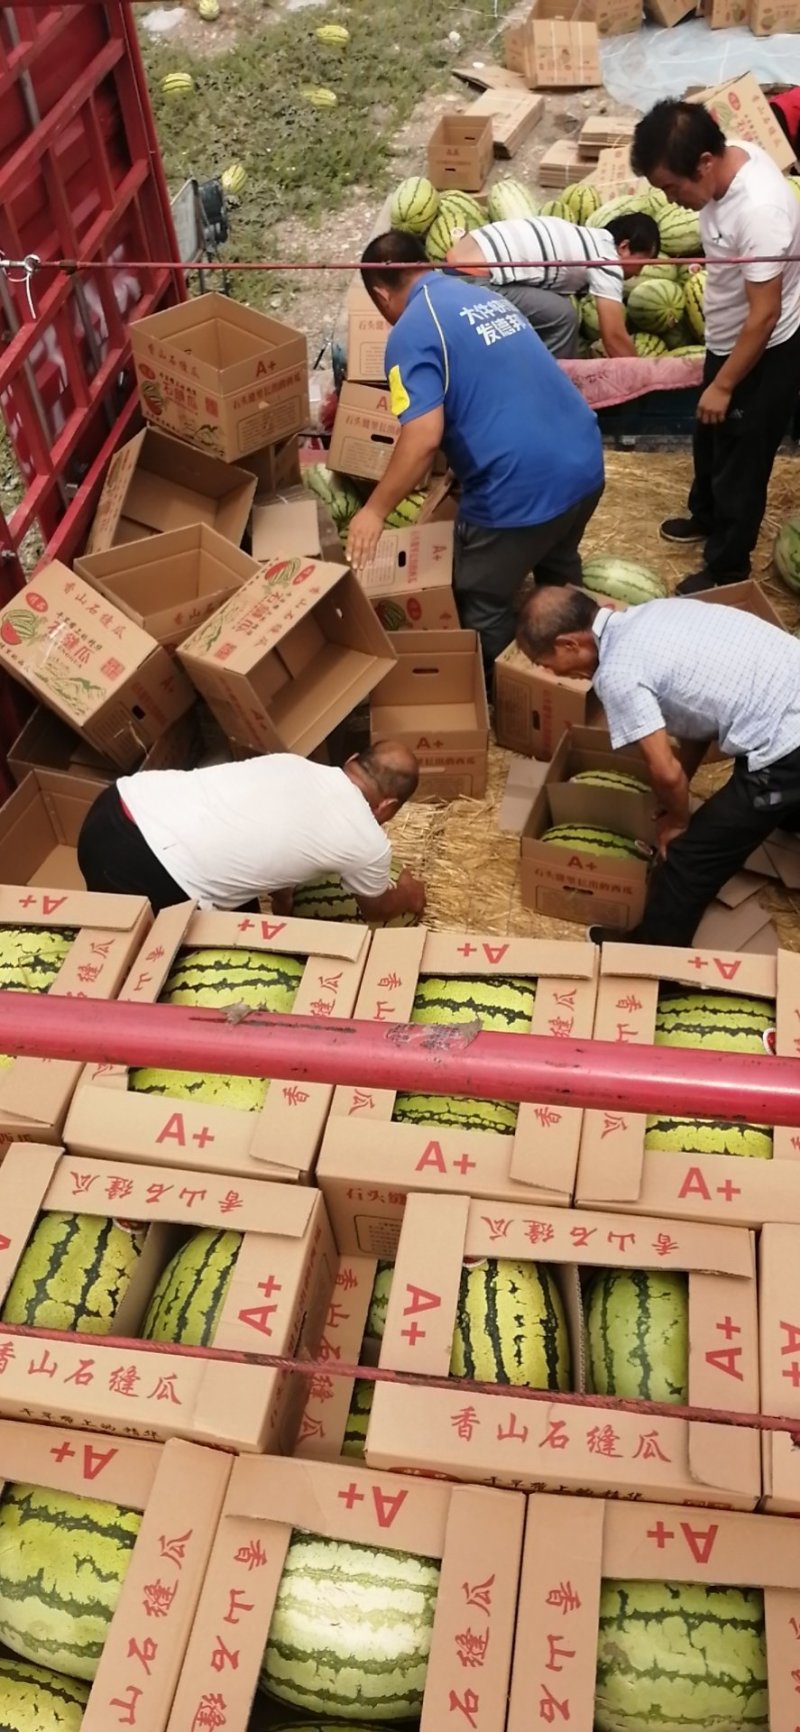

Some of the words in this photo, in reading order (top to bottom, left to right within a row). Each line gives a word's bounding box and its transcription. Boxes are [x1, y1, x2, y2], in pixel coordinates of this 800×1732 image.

[255, 360, 278, 378] A+
[64, 581, 126, 641] 香山石缝瓜
[416, 736, 445, 751] A+
[568, 855, 598, 871] A+
[19, 894, 69, 916] A+
[238, 918, 287, 940] A+
[457, 942, 510, 964] A+
[687, 956, 742, 980] A+
[155, 1112, 216, 1149] A+
[414, 1140, 477, 1175] A+
[69, 1170, 245, 1213] 香山石缝瓜
[676, 1167, 742, 1202] A+
[480, 1215, 680, 1257] 香山石缝瓜
[237, 1274, 283, 1337] A+
[400, 1283, 442, 1347] A+
[704, 1315, 744, 1382] A+
[449, 1405, 673, 1463] 香山石缝瓜
[50, 1441, 119, 1480] A+
[338, 1482, 409, 1528] A+
[646, 1520, 719, 1564] A+
[110, 1529, 193, 1726] 山石缝瓜
[449, 1573, 495, 1728] 石缝瓜
[539, 1580, 581, 1723] 香山石
